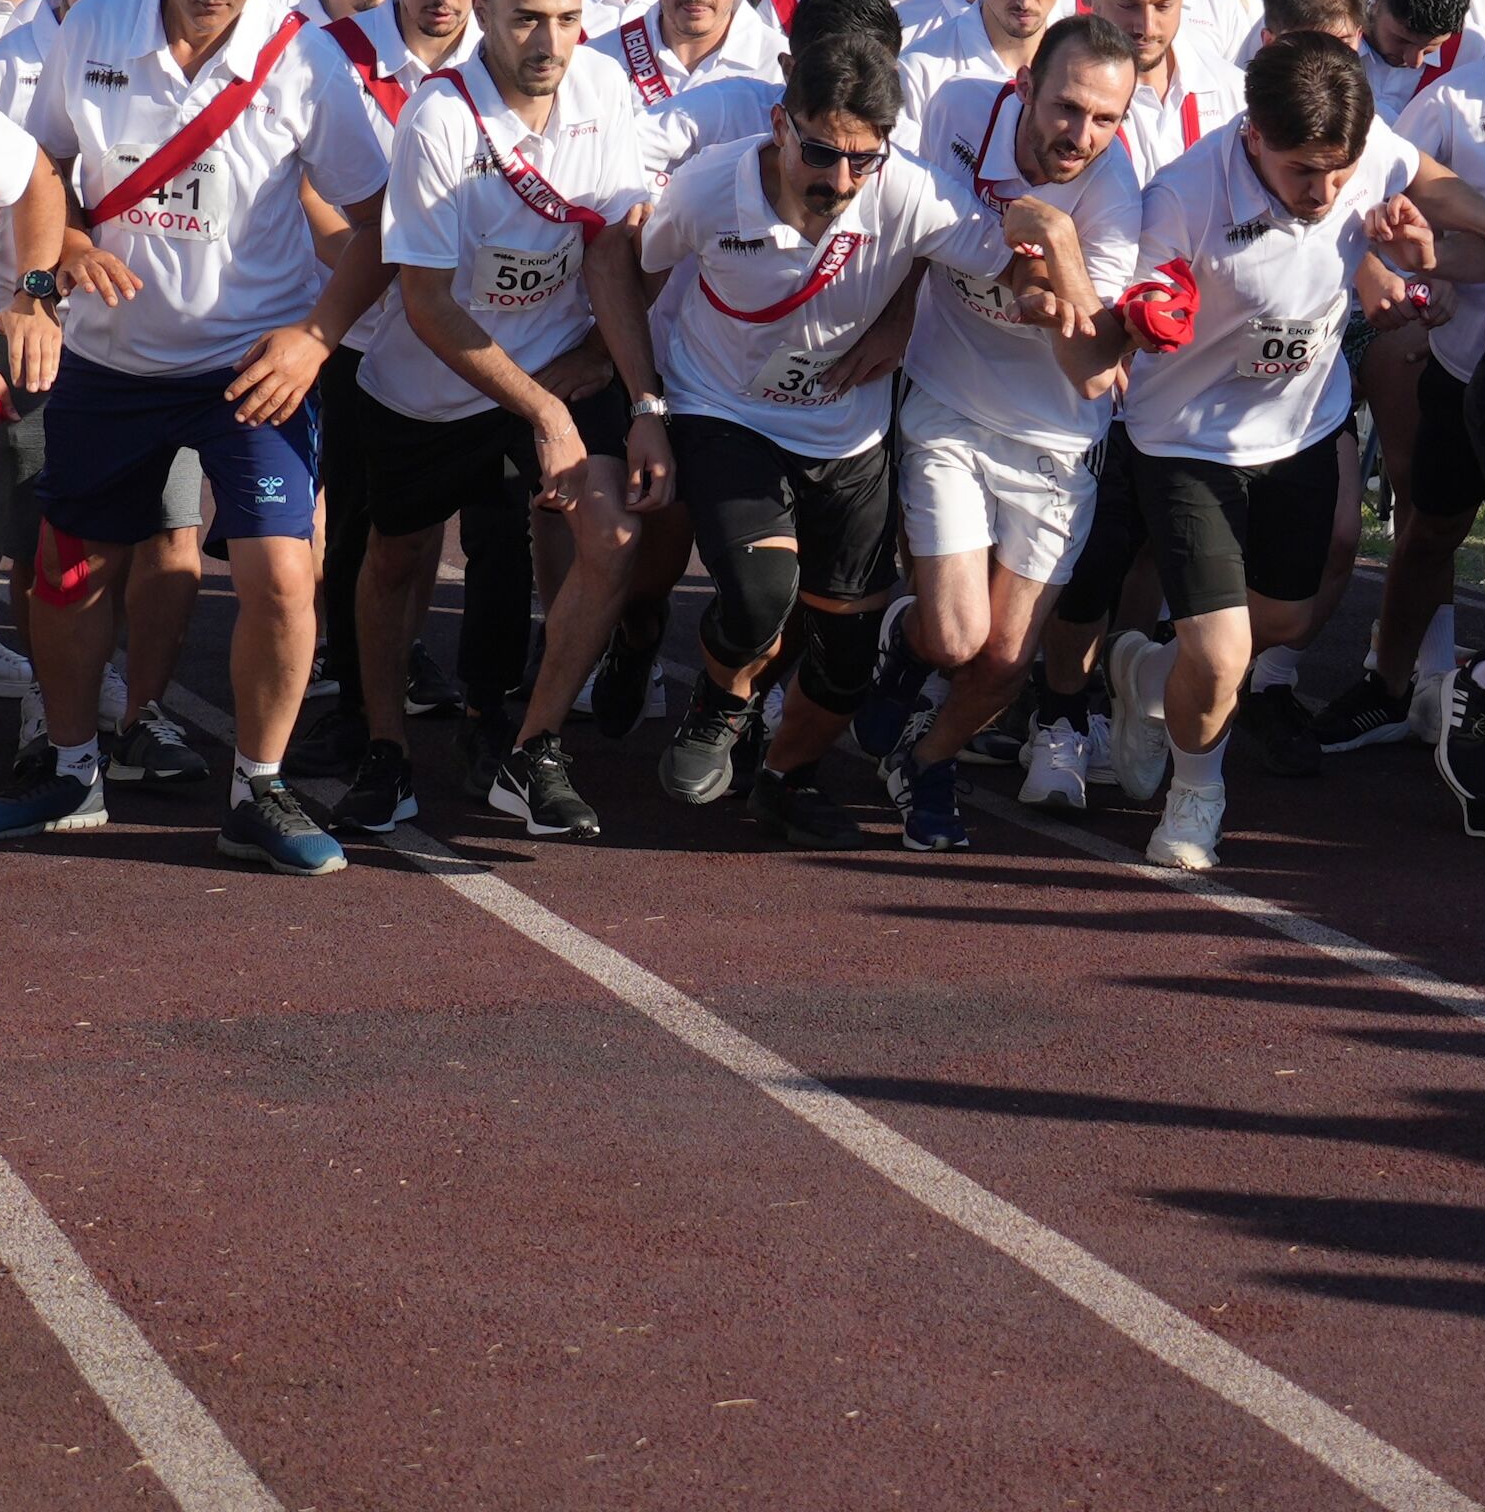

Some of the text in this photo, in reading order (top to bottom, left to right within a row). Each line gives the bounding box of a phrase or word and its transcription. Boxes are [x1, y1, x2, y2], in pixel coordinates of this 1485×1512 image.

[570, 126, 599, 137] OYOTA
[190, 162, 216, 173] 2026
[147, 178, 201, 210] 4-1
[203, 220, 211, 233] 1
[496, 254, 569, 291] 50-1
[485, 279, 565, 306] TOYOTA
[762, 388, 839, 406] TOYOTA
